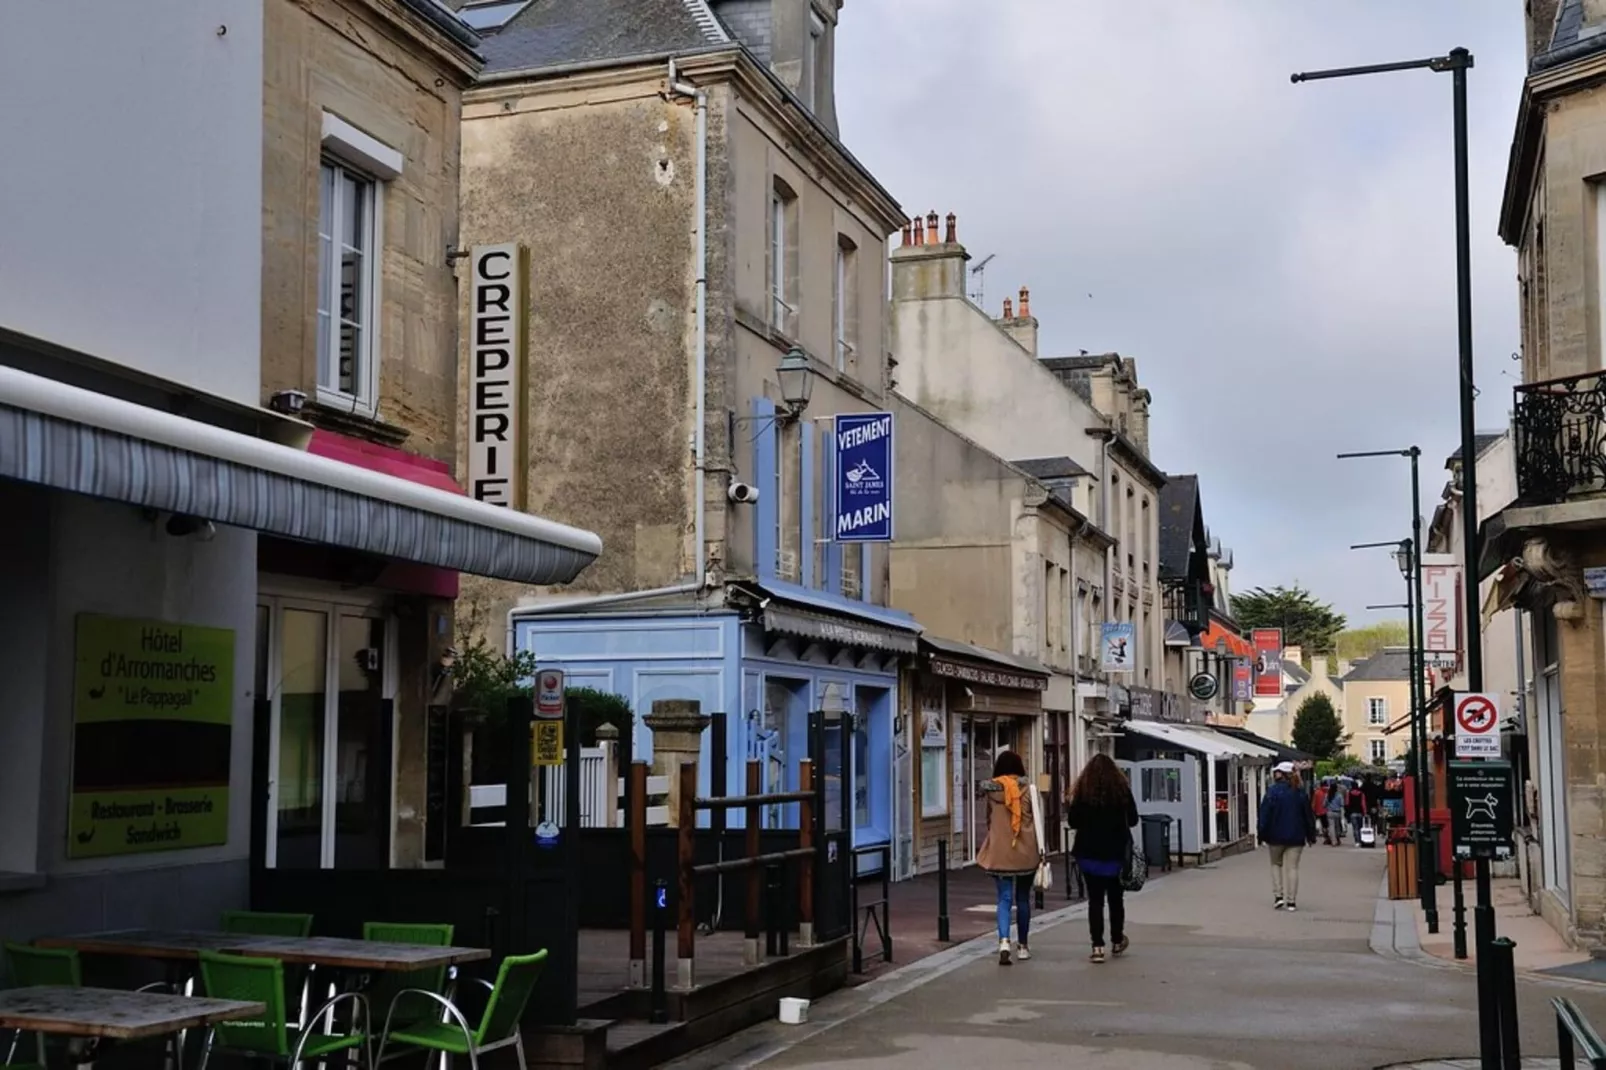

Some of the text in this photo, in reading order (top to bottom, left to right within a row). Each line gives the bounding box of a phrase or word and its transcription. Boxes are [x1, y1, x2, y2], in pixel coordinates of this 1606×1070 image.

[475, 251, 511, 507] CREPERIE
[838, 417, 890, 450] VETEMENT
[838, 501, 890, 533] MARIN
[141, 627, 182, 653] Hôtel
[101, 651, 216, 683] d'Arromanches
[91, 800, 155, 819] Restaurant
[165, 794, 213, 815] Brasserie
[126, 821, 181, 844] Sandwich
